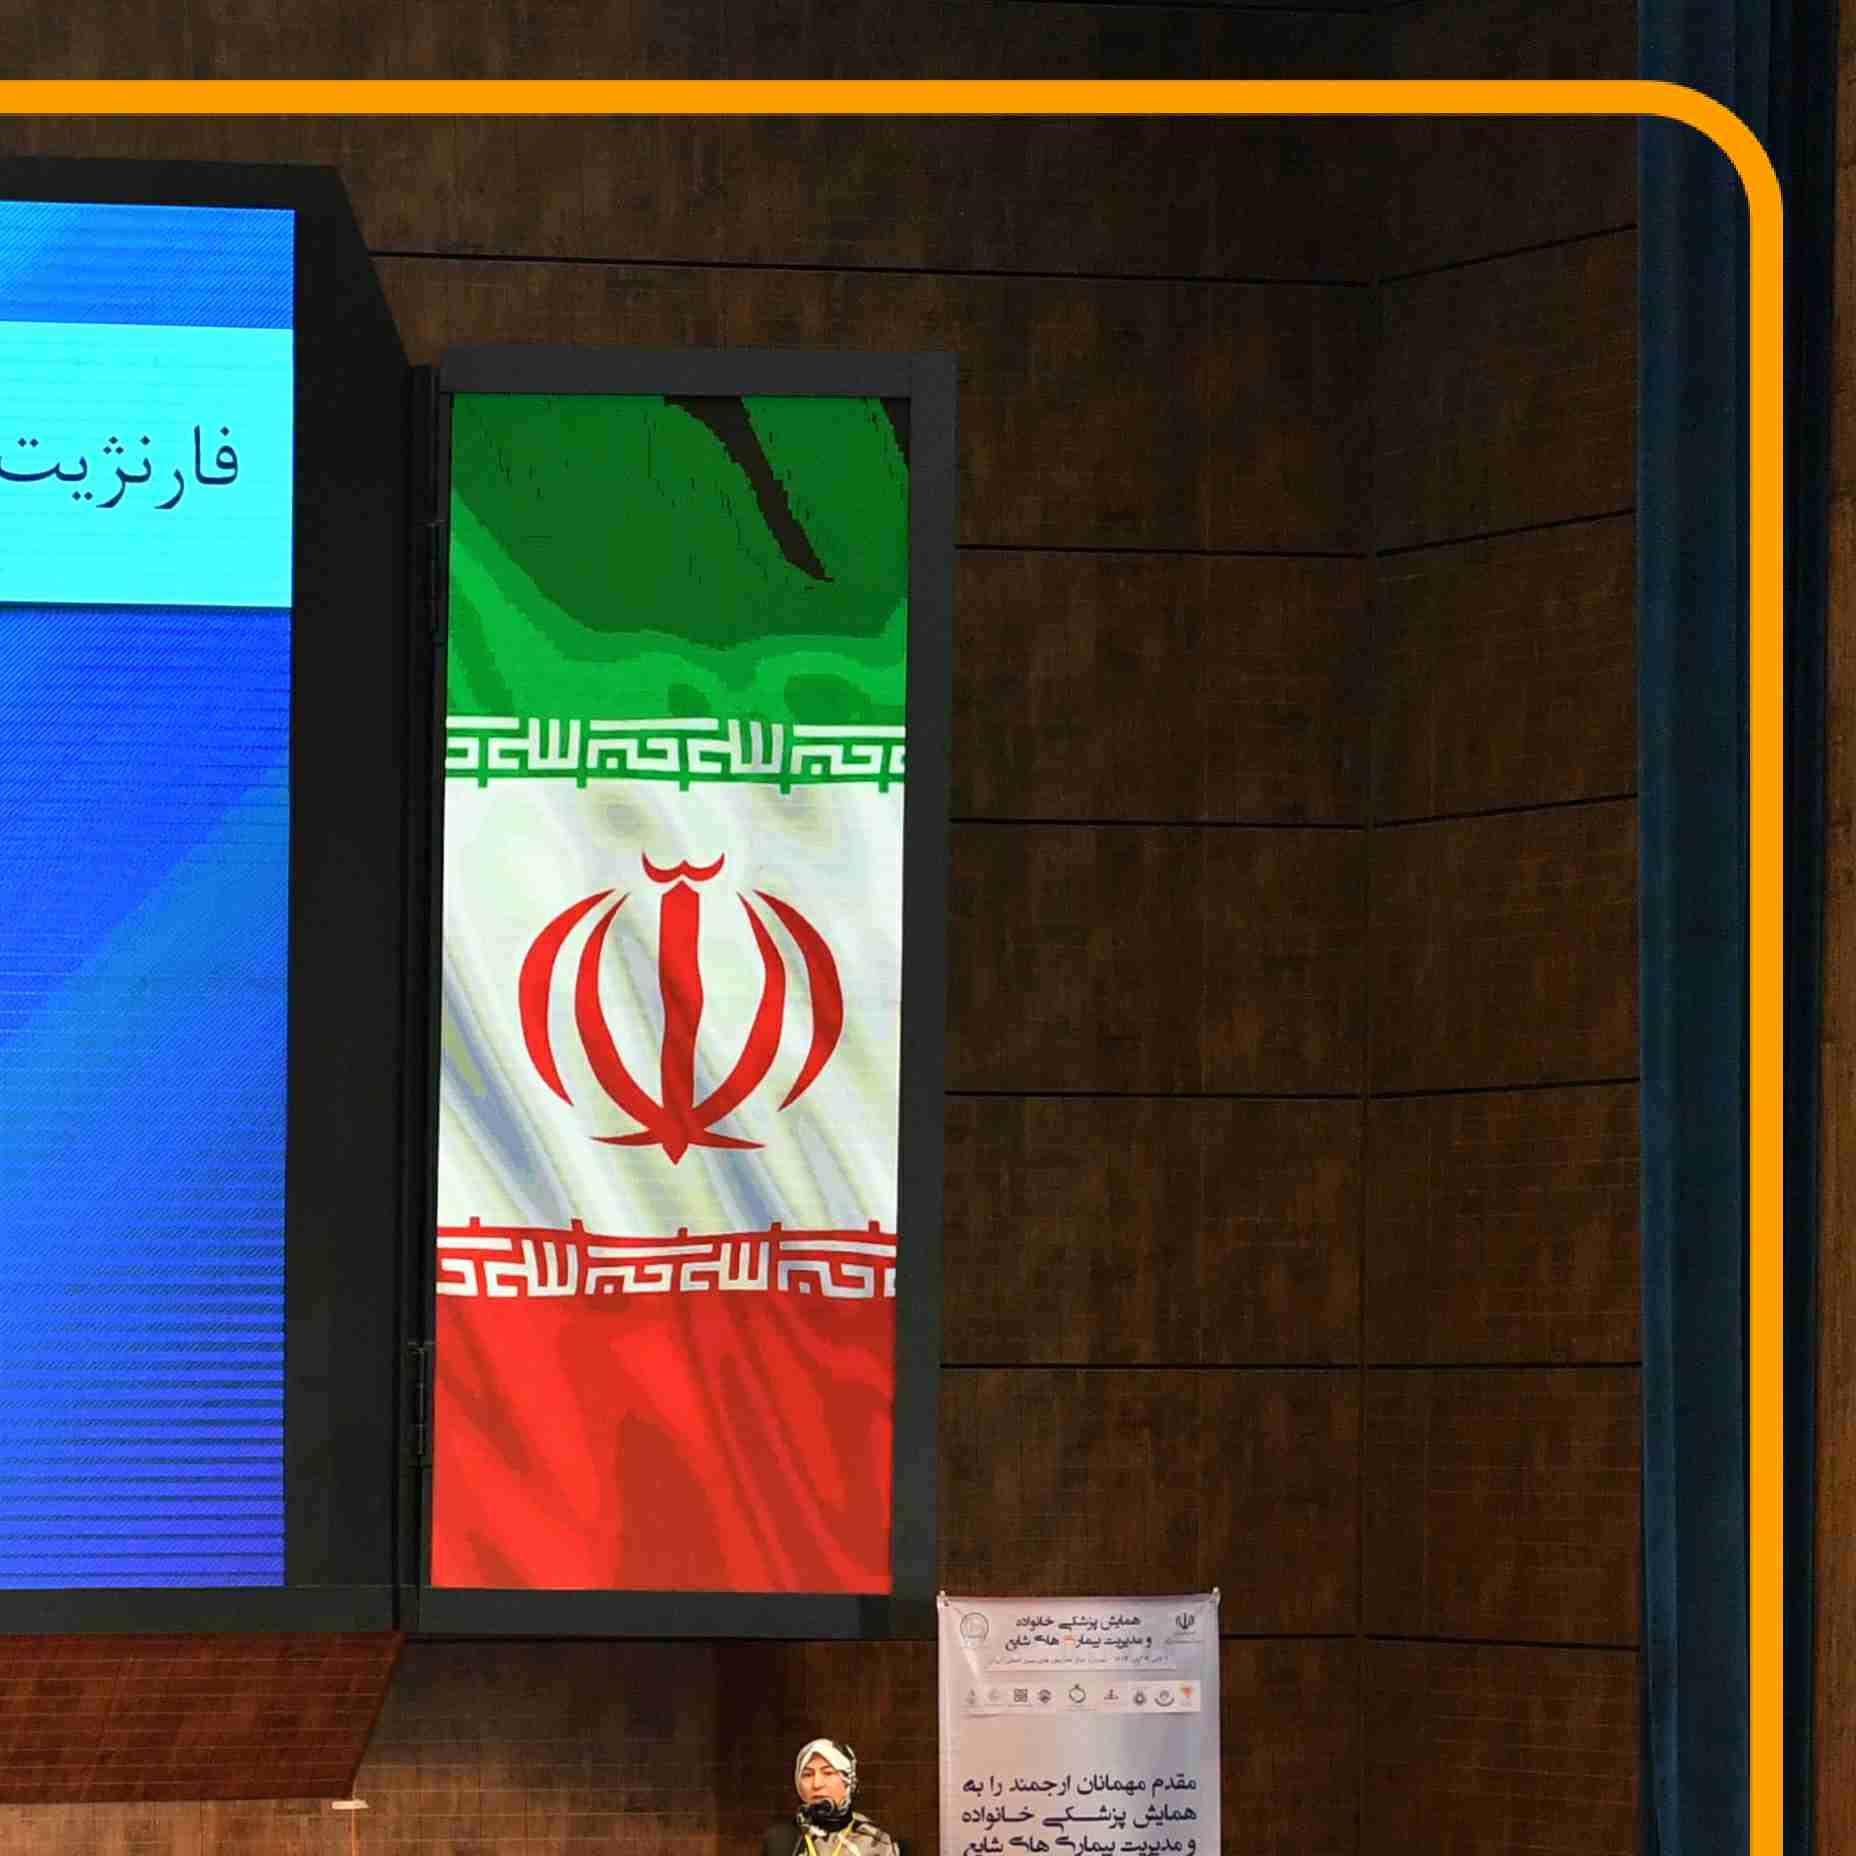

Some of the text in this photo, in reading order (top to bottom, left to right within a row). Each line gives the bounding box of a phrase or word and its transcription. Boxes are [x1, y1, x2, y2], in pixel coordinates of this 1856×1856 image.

[963, 1774, 1196, 1798] مقدم مهمانان ارجمند را به
[962, 1804, 1196, 1832] همایش پزشکی خانواده
[1009, 1836, 1049, 1852] های
[1055, 1836, 1115, 1856] بیماری
[1187, 1842, 1196, 1856] و
